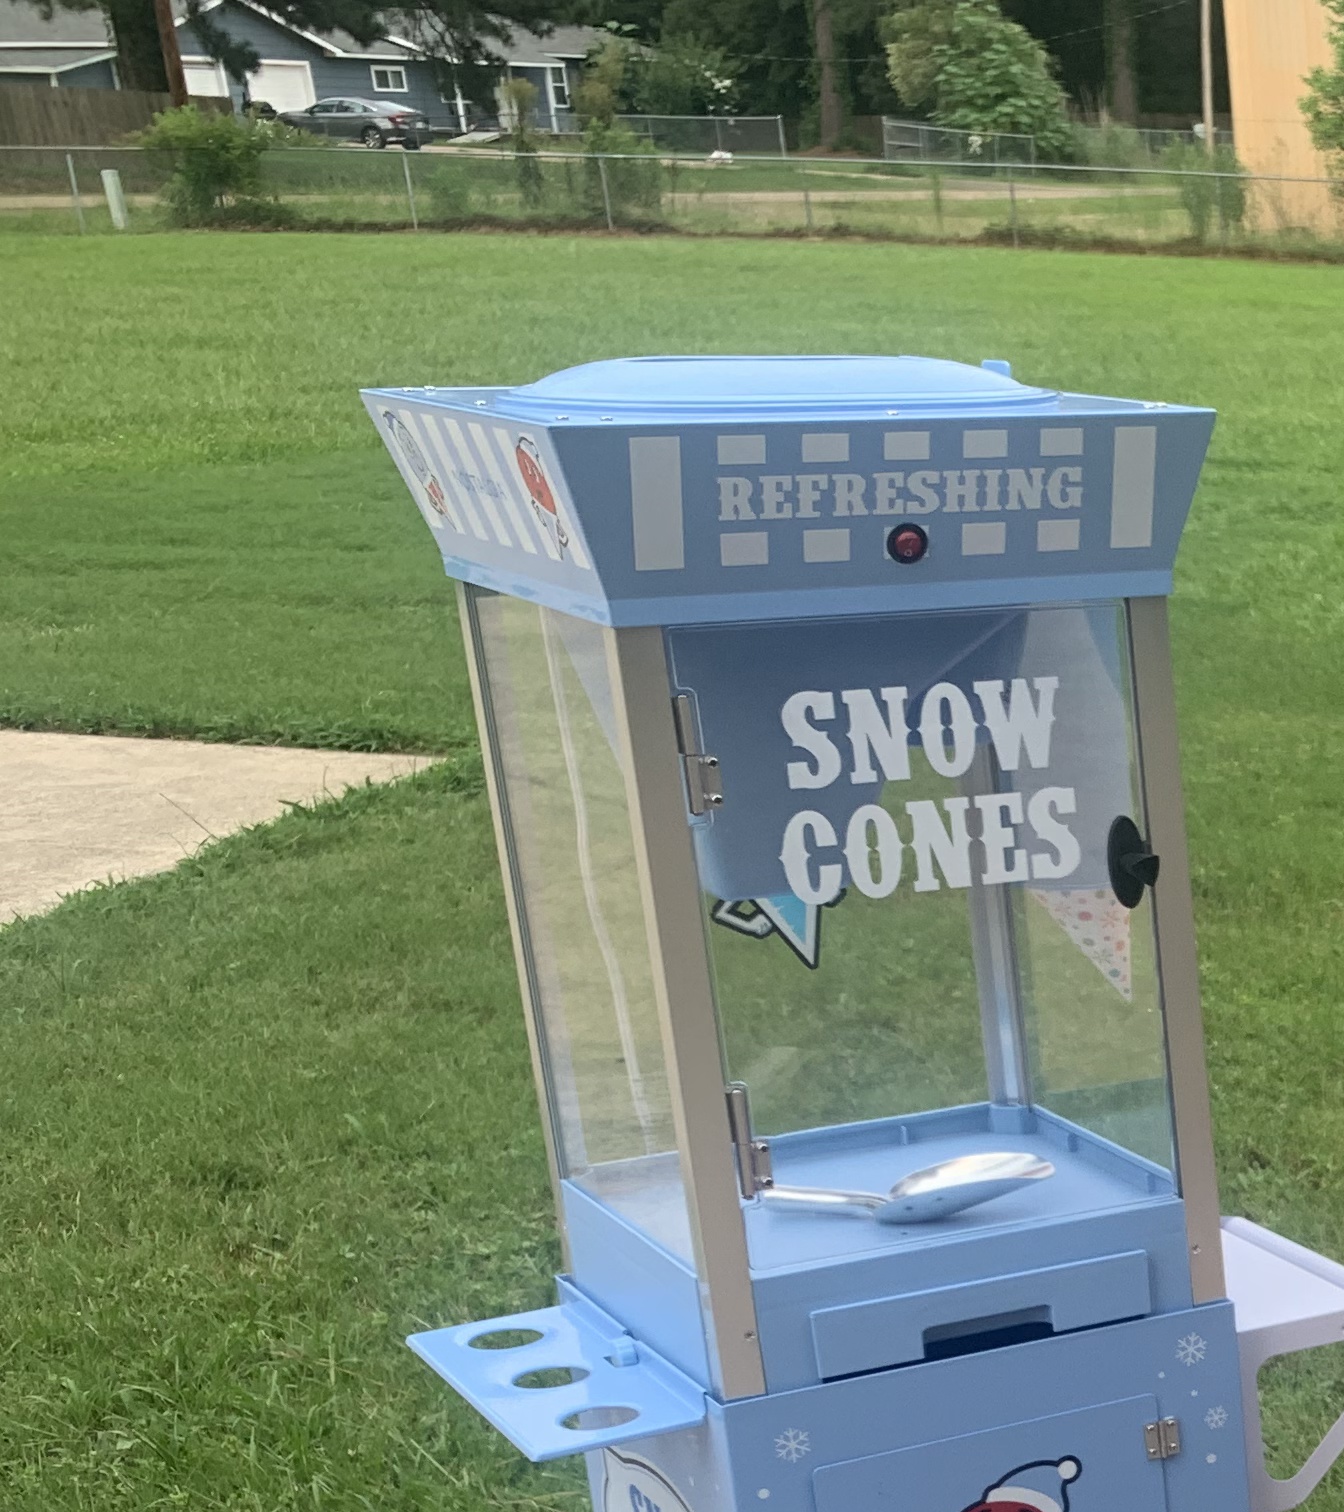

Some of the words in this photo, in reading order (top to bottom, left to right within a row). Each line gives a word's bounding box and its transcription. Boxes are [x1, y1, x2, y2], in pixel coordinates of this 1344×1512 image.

[717, 466, 1084, 522] REFRESHING
[780, 676, 1060, 790] SNOW
[778, 786, 1082, 906] CONES
